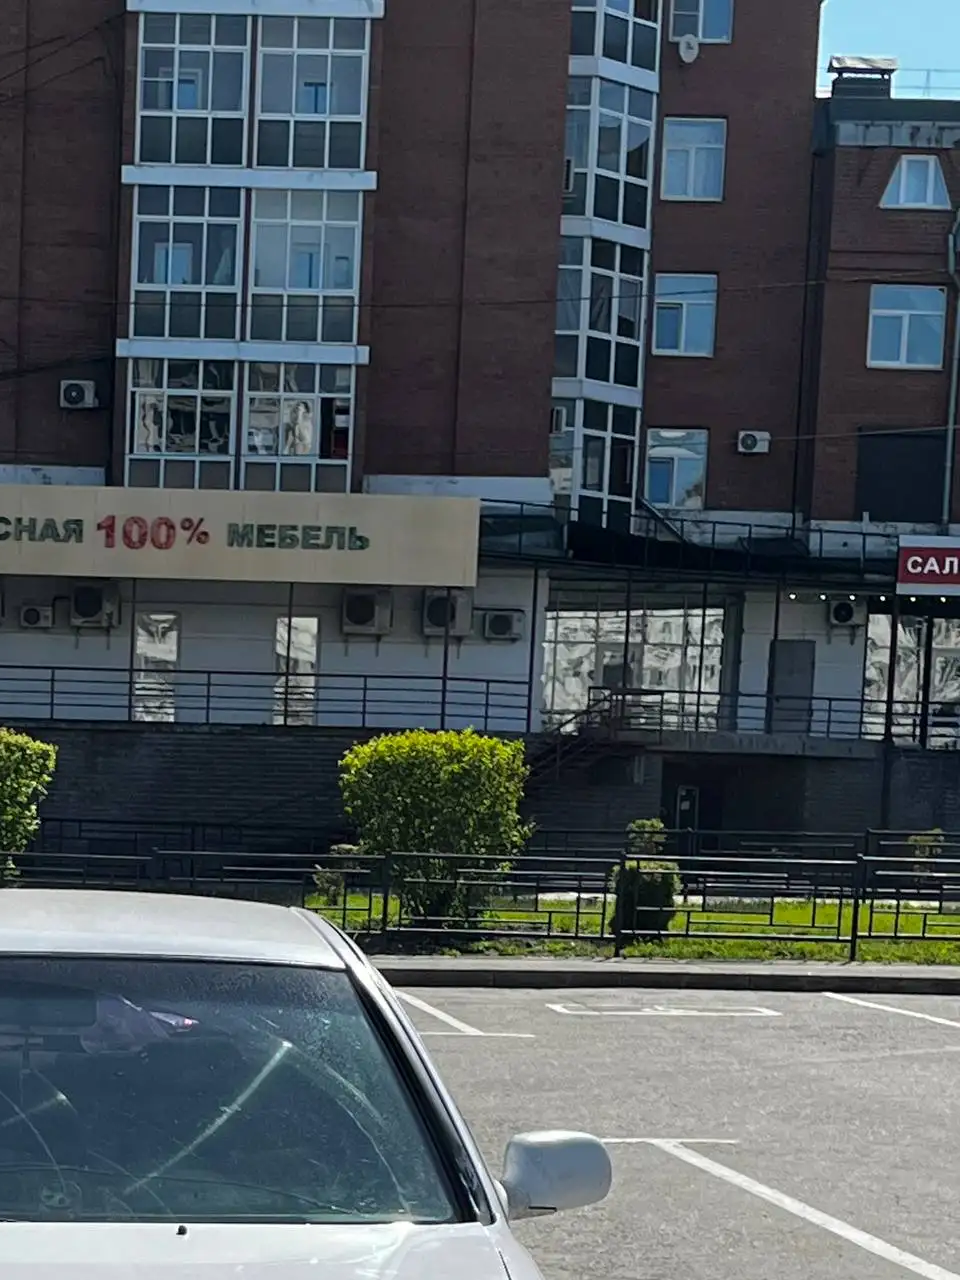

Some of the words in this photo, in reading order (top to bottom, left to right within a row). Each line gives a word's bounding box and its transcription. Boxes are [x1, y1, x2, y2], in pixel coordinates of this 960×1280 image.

[96, 515, 210, 550] 100%
[227, 523, 370, 550] МЕБЕЛЬ
[906, 556, 959, 575] САЛ
